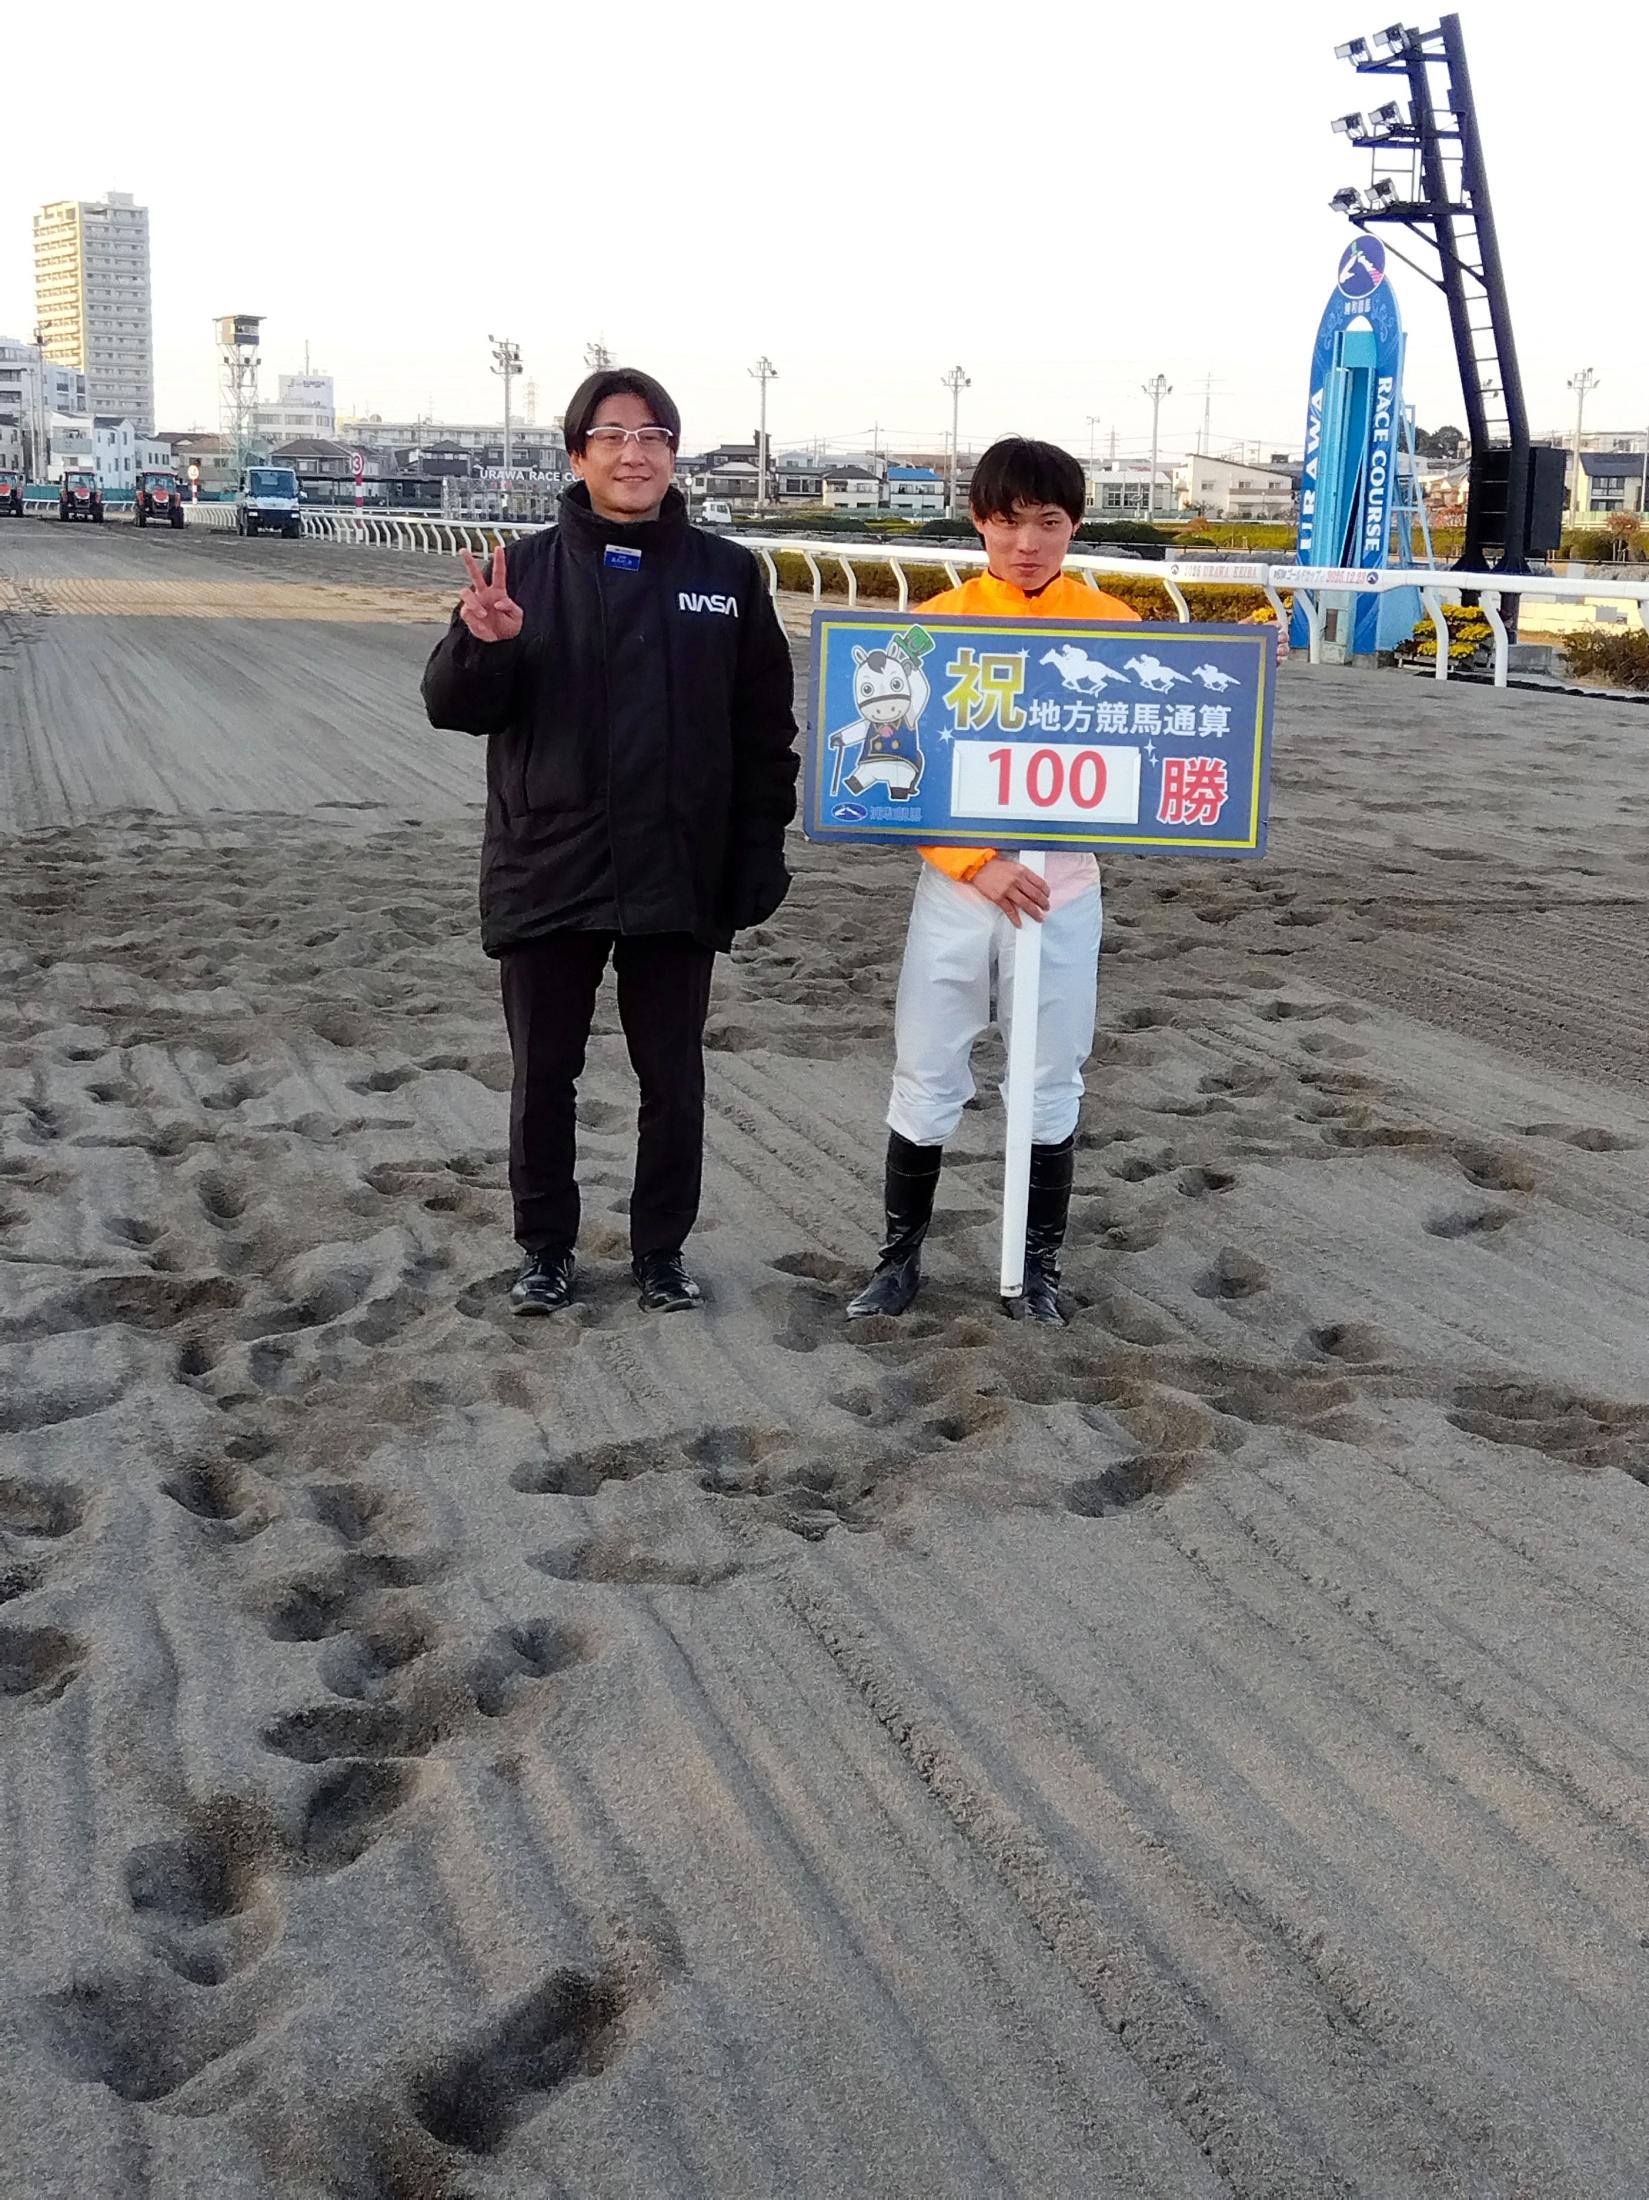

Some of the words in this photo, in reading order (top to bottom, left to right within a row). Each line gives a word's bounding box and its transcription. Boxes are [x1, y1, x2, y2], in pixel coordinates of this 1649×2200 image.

[1373, 376, 1393, 442] RACE
[353, 453, 361, 471] 3
[480, 469, 525, 480] URAWA
[529, 471, 561, 482] RACE
[1300, 388, 1324, 550] URAWA
[1365, 450, 1387, 552] COURSE
[678, 592, 739, 619] NASA
[943, 647, 1027, 732] 祝
[1029, 699, 1232, 738] 地方競馬通算
[988, 748, 1108, 809] 100
[1157, 755, 1229, 825] 勝
